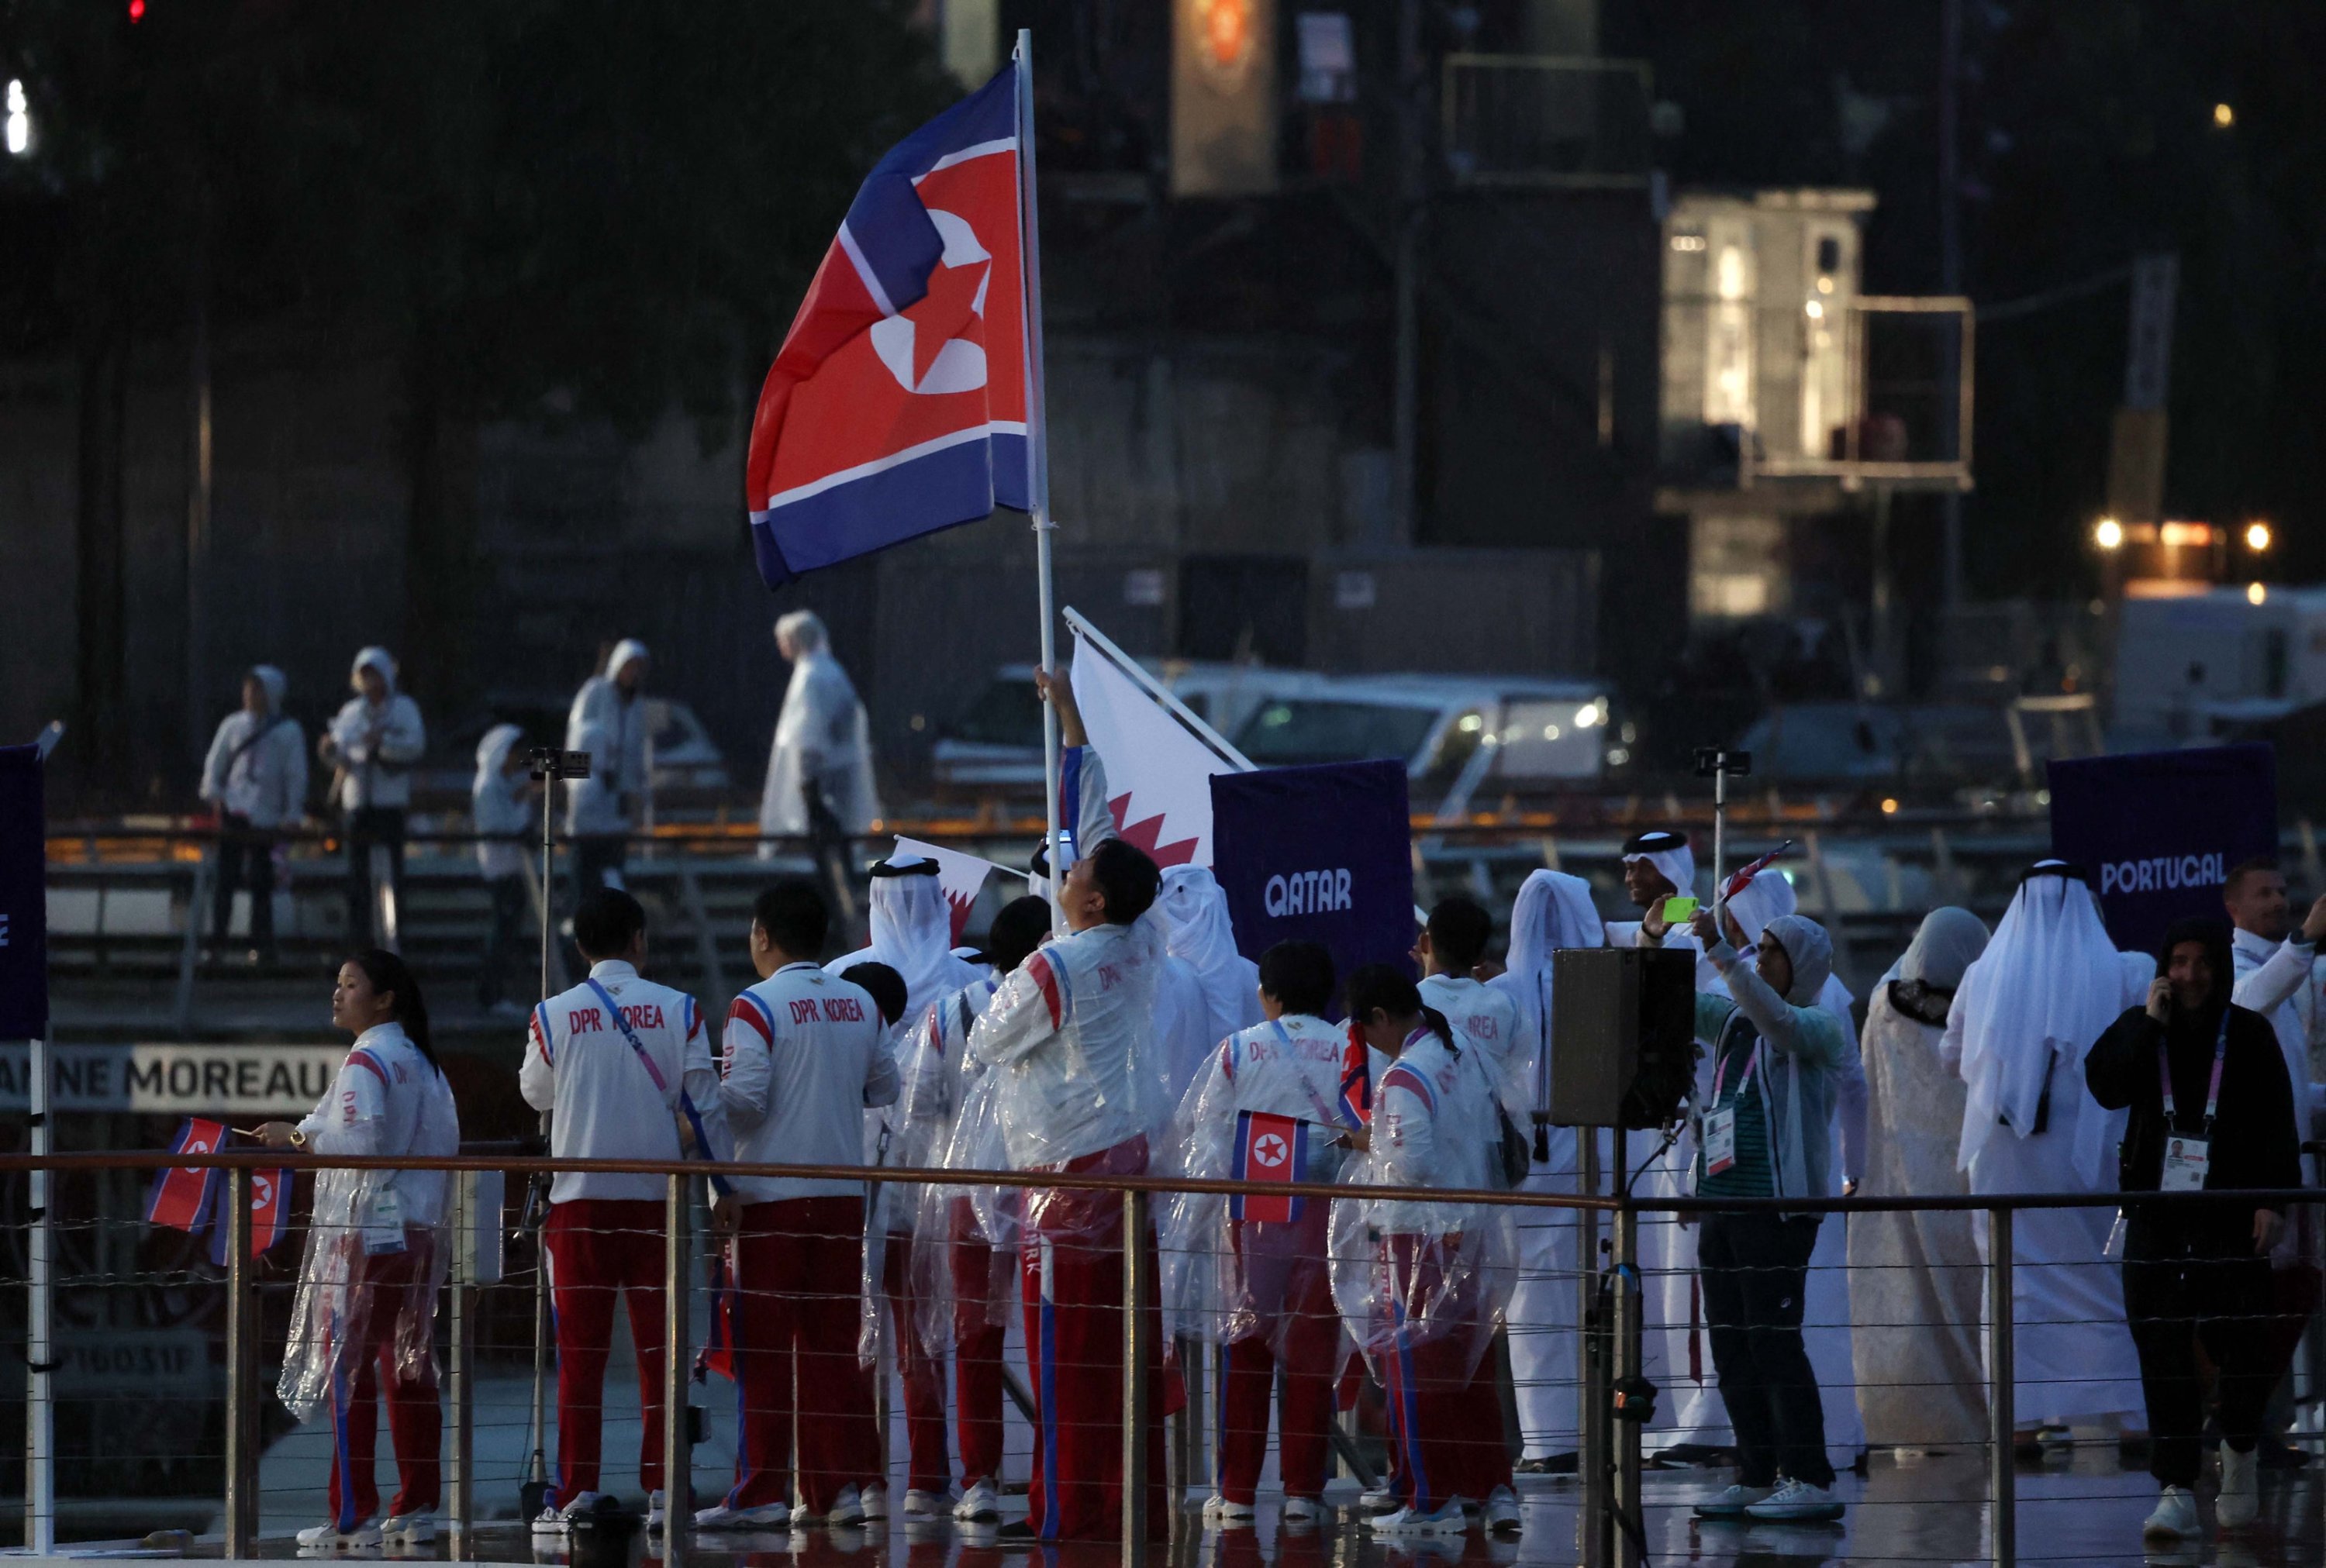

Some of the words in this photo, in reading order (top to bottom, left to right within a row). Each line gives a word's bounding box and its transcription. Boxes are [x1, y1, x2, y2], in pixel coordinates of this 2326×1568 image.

[1265, 867, 1351, 918] QATAR
[2101, 852, 2228, 895] PORTUGAL
[569, 1008, 603, 1035] DPR
[789, 1000, 820, 1025] DPR
[822, 998, 866, 1022] KOREA
[123, 1058, 327, 1098] MOREAU
[1023, 1218, 1042, 1277] PRK
